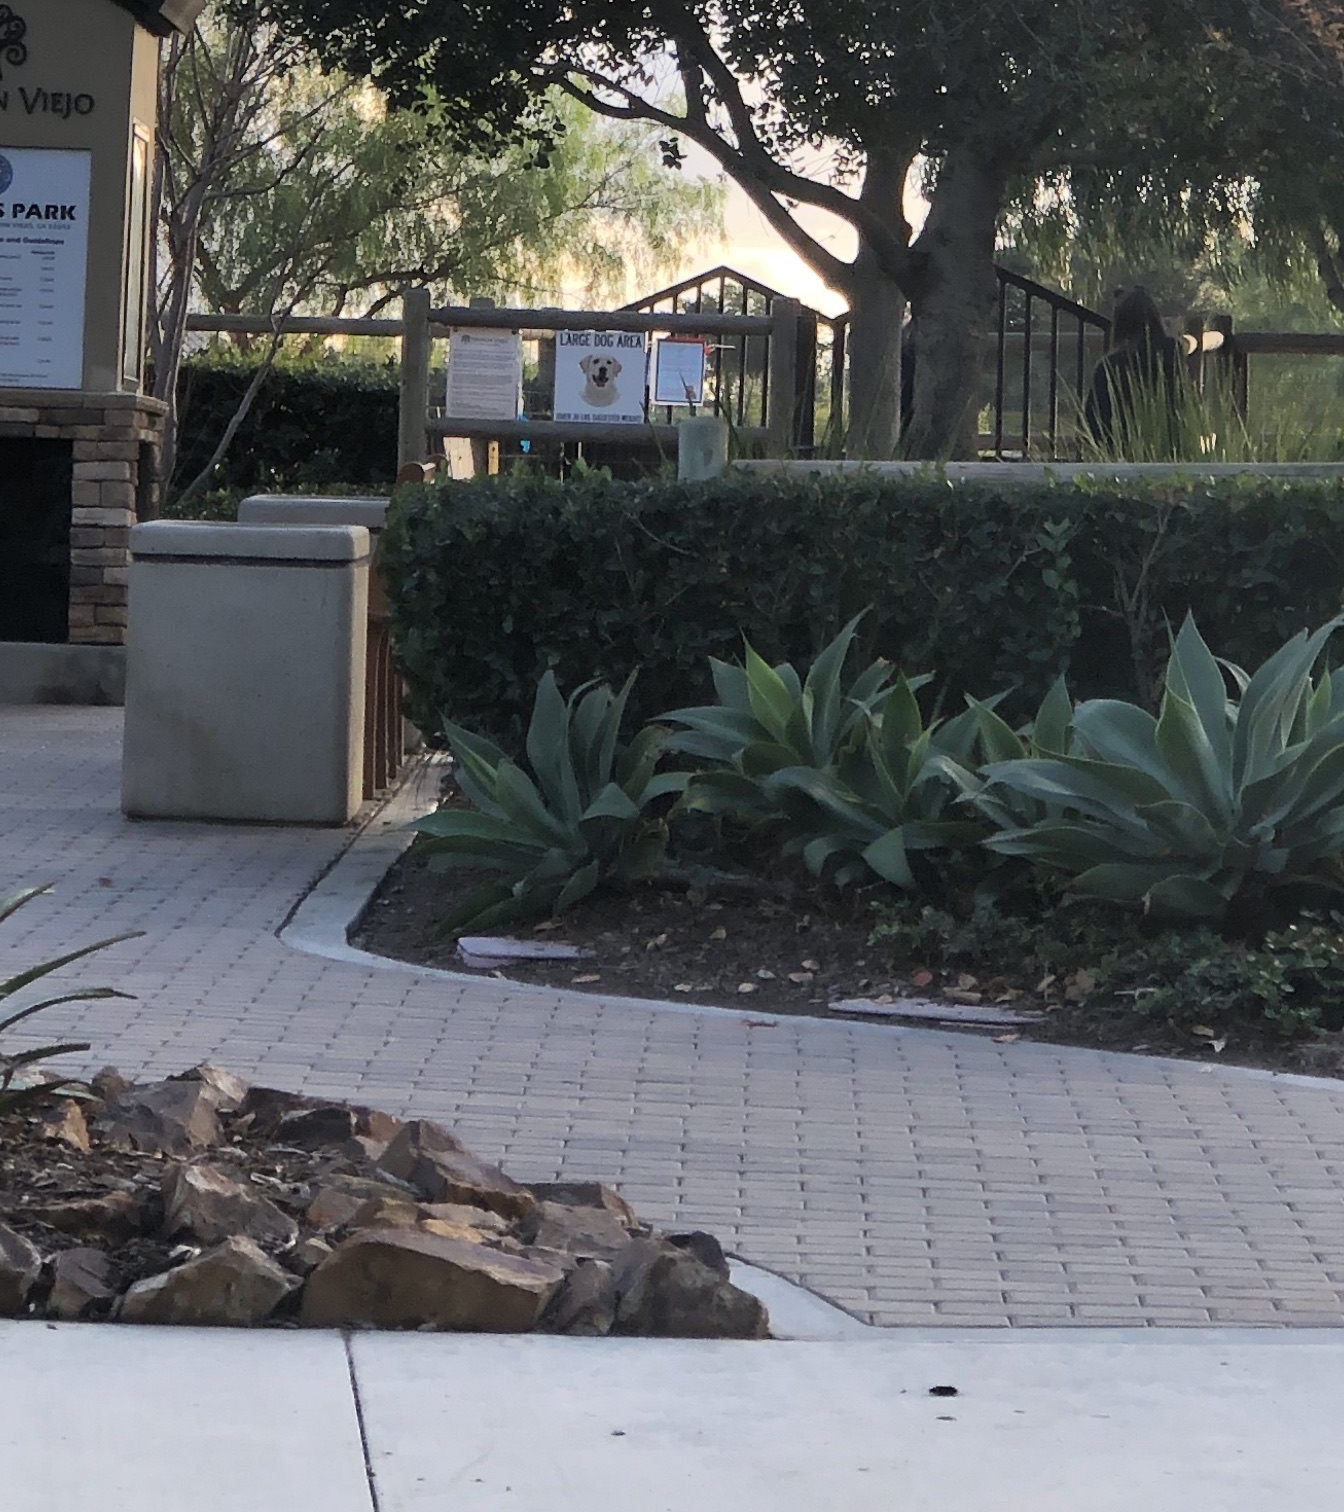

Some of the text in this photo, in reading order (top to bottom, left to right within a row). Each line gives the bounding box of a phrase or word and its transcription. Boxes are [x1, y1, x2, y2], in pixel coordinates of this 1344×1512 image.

[17, 86, 96, 120] VIEJO
[12, 203, 77, 221] PARK
[559, 332, 643, 349] LARGE DOG AREA
